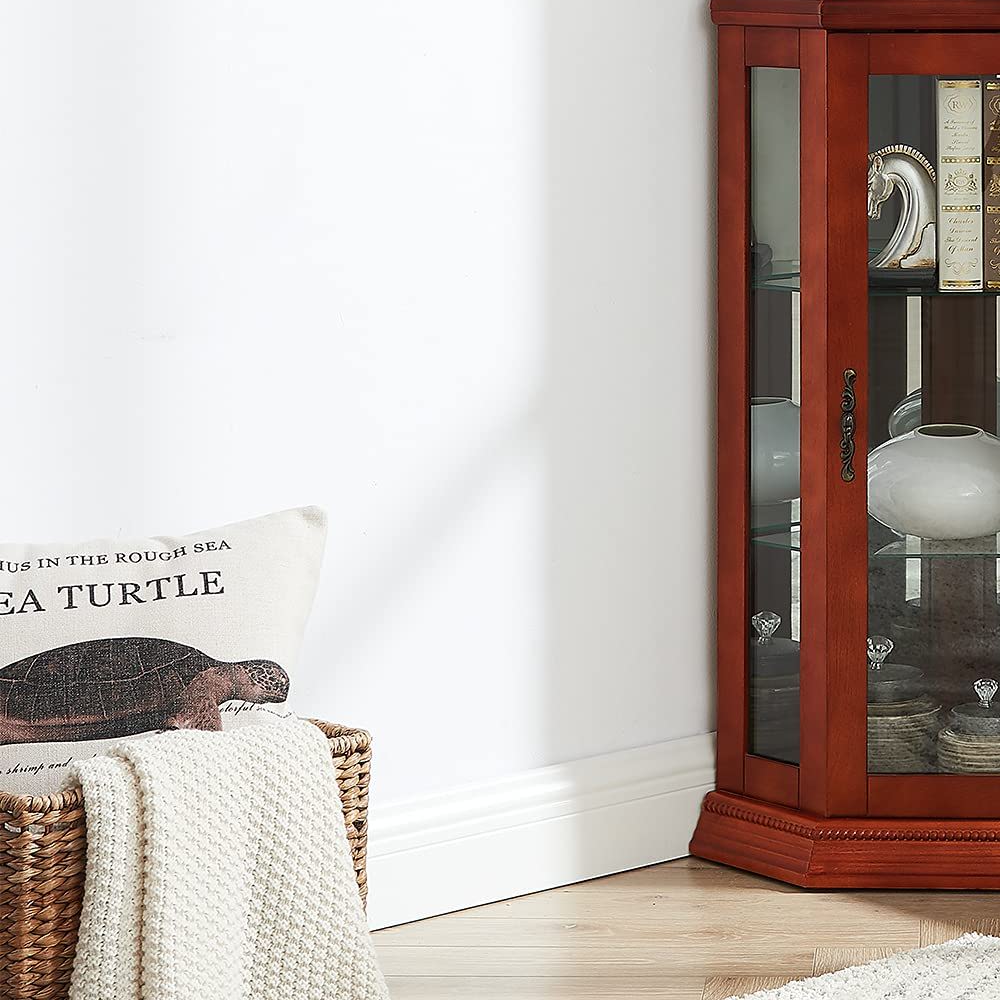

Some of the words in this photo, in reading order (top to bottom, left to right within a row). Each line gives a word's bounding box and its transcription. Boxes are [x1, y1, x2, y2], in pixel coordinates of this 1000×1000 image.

[37, 556, 61, 569] IN
[65, 554, 109, 566] THE
[114, 545, 188, 564] ROUGH
[193, 539, 232, 553] SEA
[57, 570, 225, 610] TURTLE
[6, 762, 45, 776] shrimp
[48, 756, 73, 770] and
